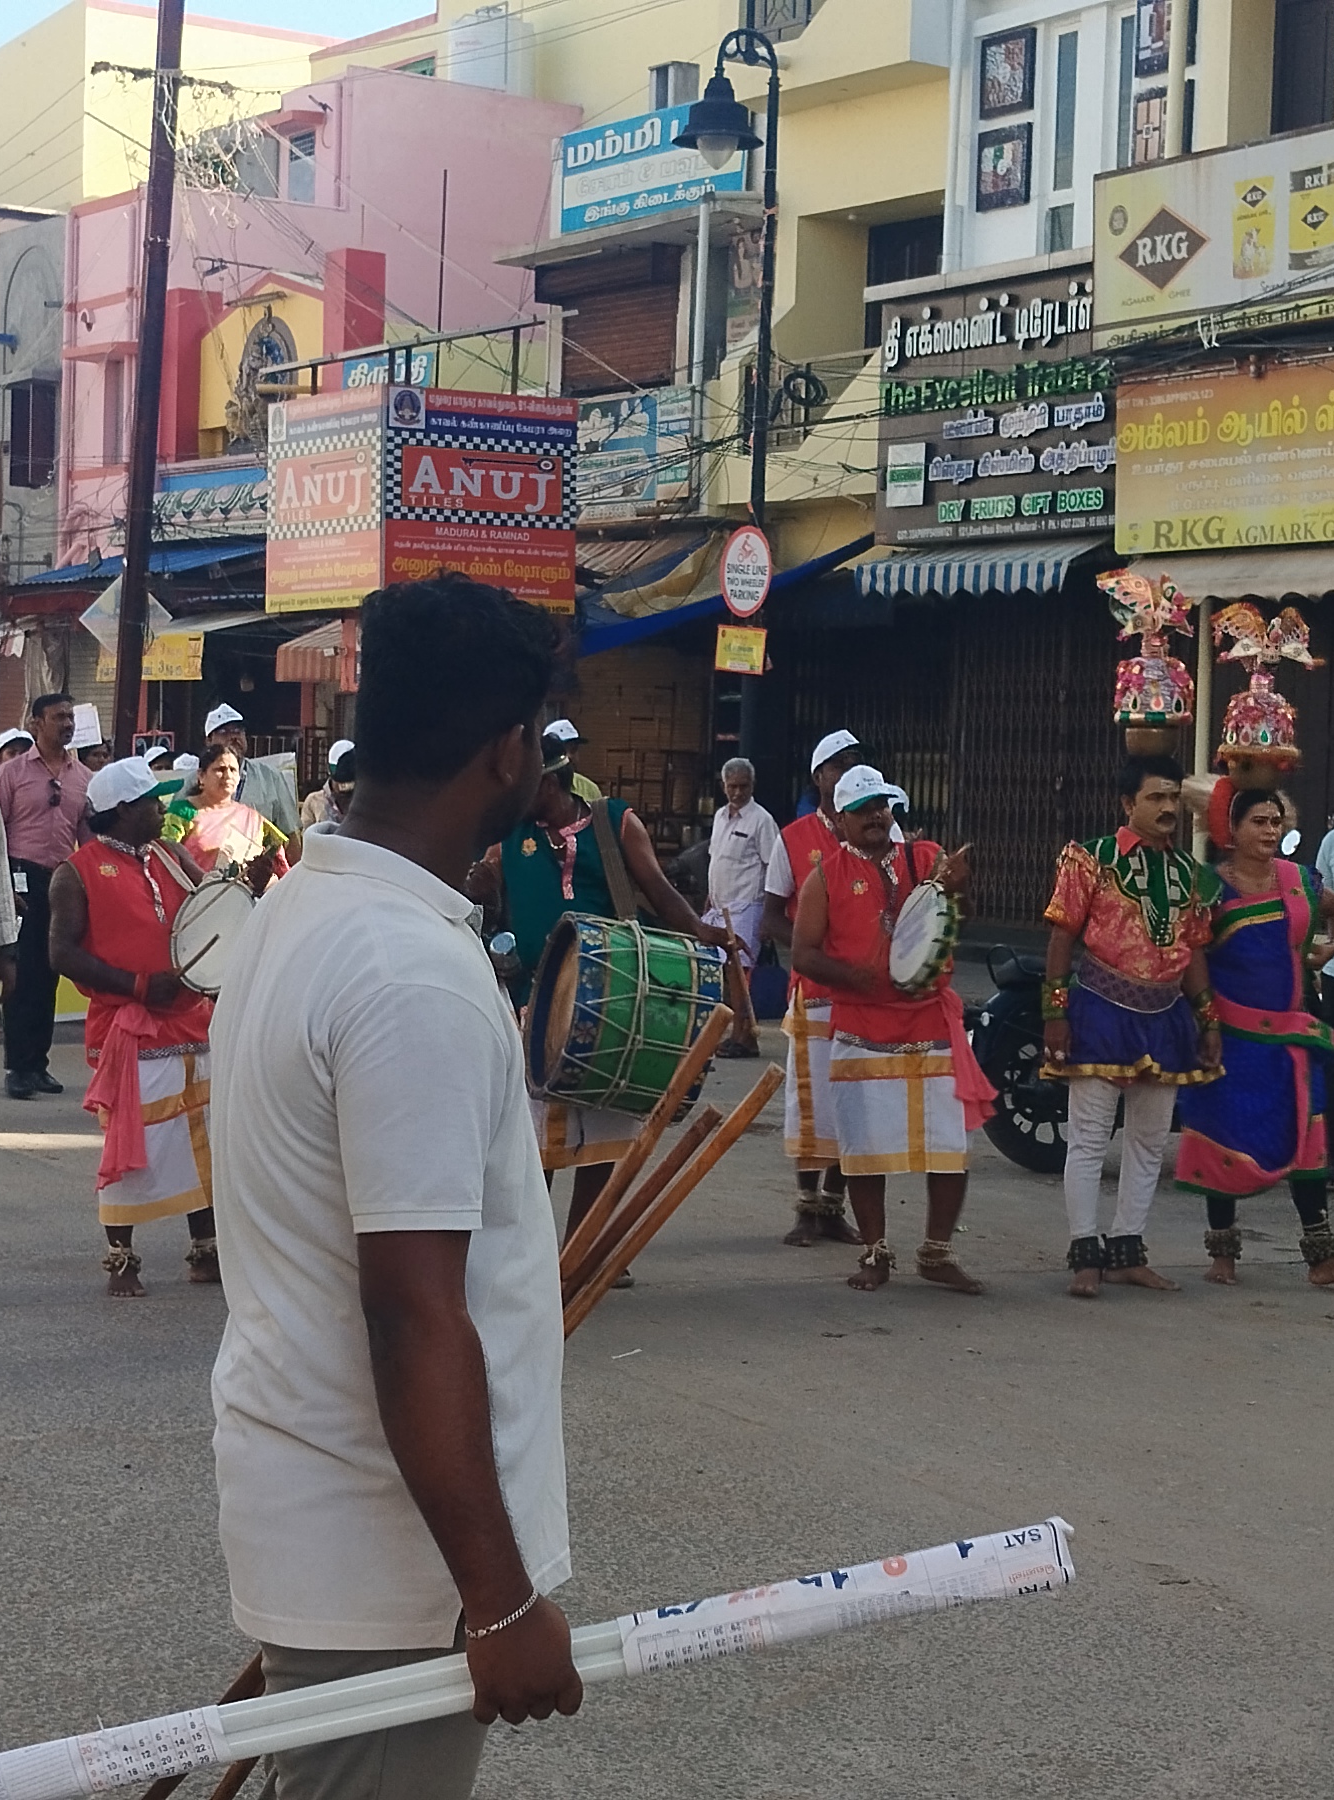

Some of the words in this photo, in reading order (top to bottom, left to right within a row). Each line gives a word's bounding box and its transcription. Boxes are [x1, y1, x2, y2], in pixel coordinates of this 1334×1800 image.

[567, 117, 661, 169] மம்மி
[583, 199, 630, 223] இங்கு
[633, 179, 716, 211] கிடைக்கும்
[1246, 191, 1263, 203] RKG
[1306, 211, 1326, 223] RKG
[1135, 231, 1189, 267] RKG
[1121, 294, 1156, 307] AGMARK
[1168, 288, 1192, 299] GHEE
[884, 316, 901, 372] தி
[920, 368, 1017, 410] Excellent
[1054, 392, 1105, 431] பாதாம்
[1118, 406, 1210, 453] அகிலம்
[1217, 394, 1308, 447] ஆயில்
[928, 454, 975, 485] பிஸ்தா
[1189, 450, 1251, 471] சமையல்
[280, 467, 368, 515] ANUJ
[409, 455, 557, 514] ANUJ
[279, 511, 311, 522] TILES
[409, 495, 464, 509] TILES
[938, 499, 966, 523] DRY
[970, 495, 1016, 521] FRUITS
[1021, 491, 1053, 516] GIFT
[1057, 487, 1104, 513] BOXES
[435, 526, 478, 539] MADURAI
[489, 529, 530, 542] RAMNAD
[1153, 516, 1226, 550] RKG
[1232, 521, 1317, 547] AGMARK
[727, 563, 751, 575] SINGLE
[752, 565, 768, 576] LINE
[727, 577, 740, 587] TWO
[741, 578, 766, 588] WHEELER
[729, 589, 760, 602] PARKING
[1004, 1528, 1042, 1550] SAT
